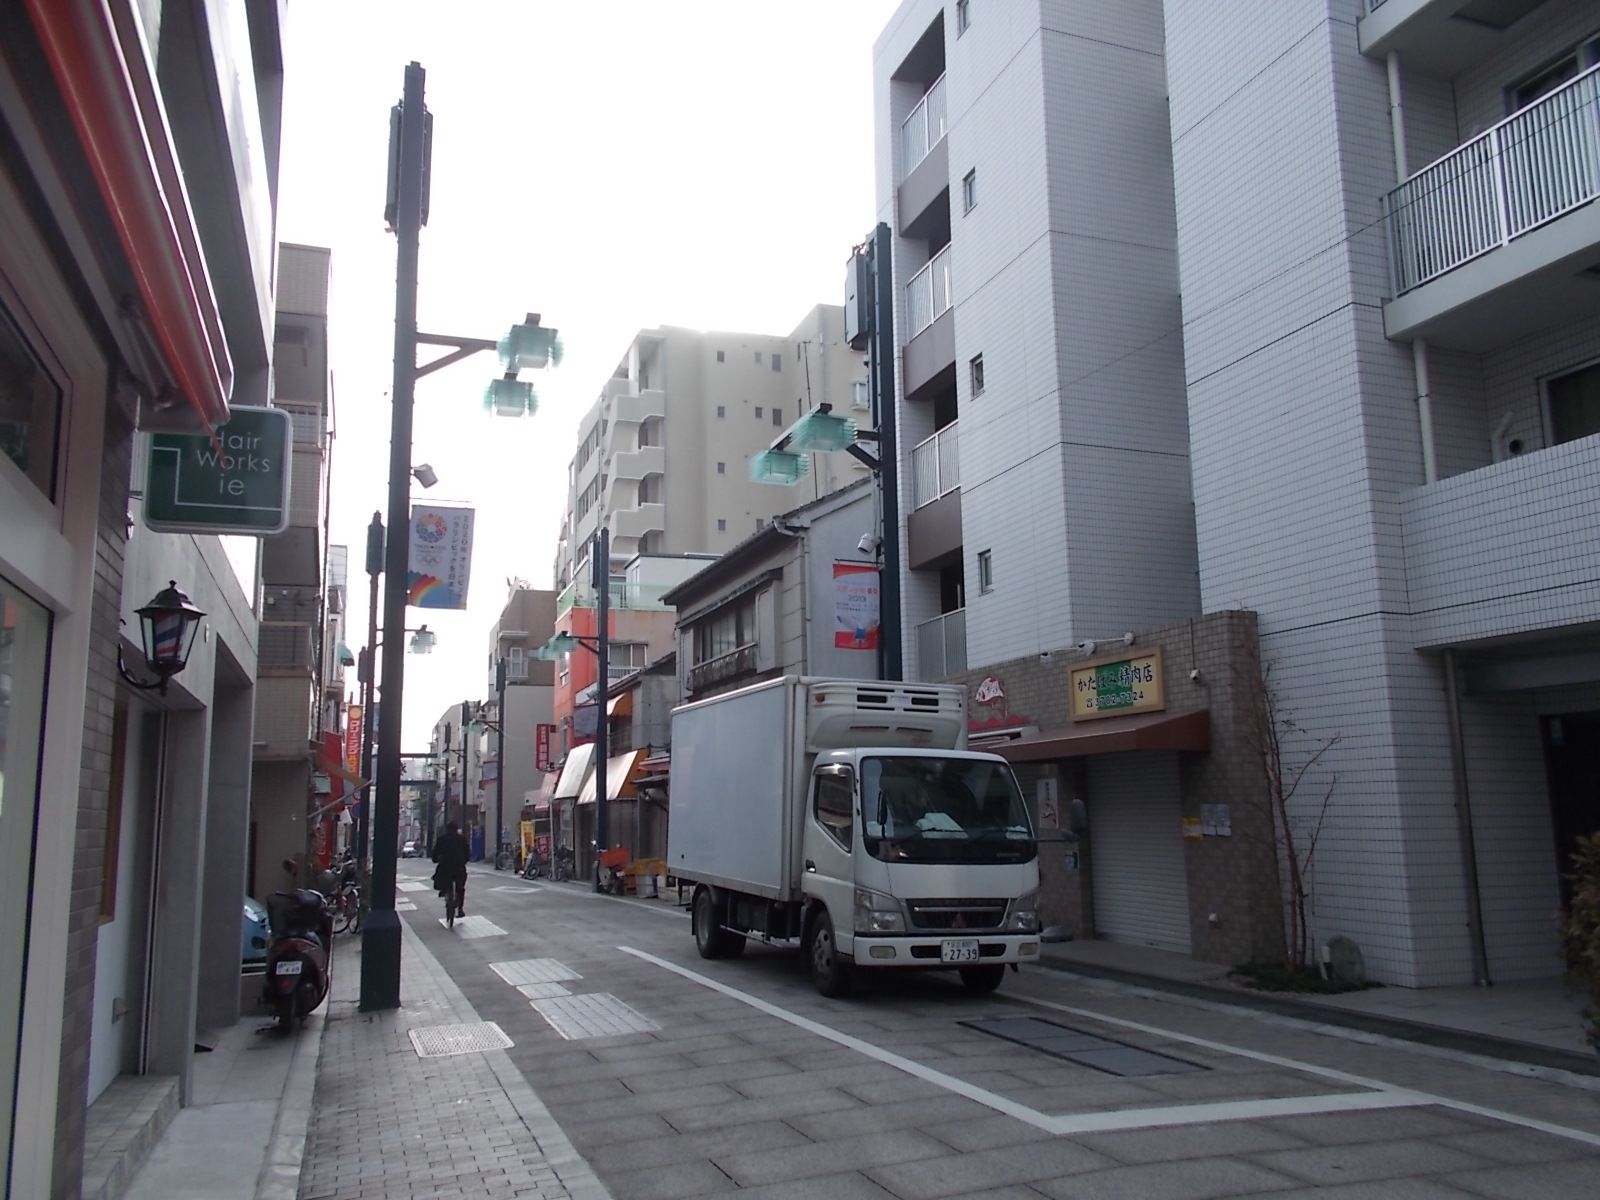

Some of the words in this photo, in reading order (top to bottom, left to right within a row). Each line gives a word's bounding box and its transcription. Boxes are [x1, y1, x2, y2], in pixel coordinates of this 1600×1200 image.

[209, 431, 261, 449] Hair
[197, 449, 271, 472] Works
[219, 473, 245, 495] ie
[950, 948, 977, 960] 27-39
